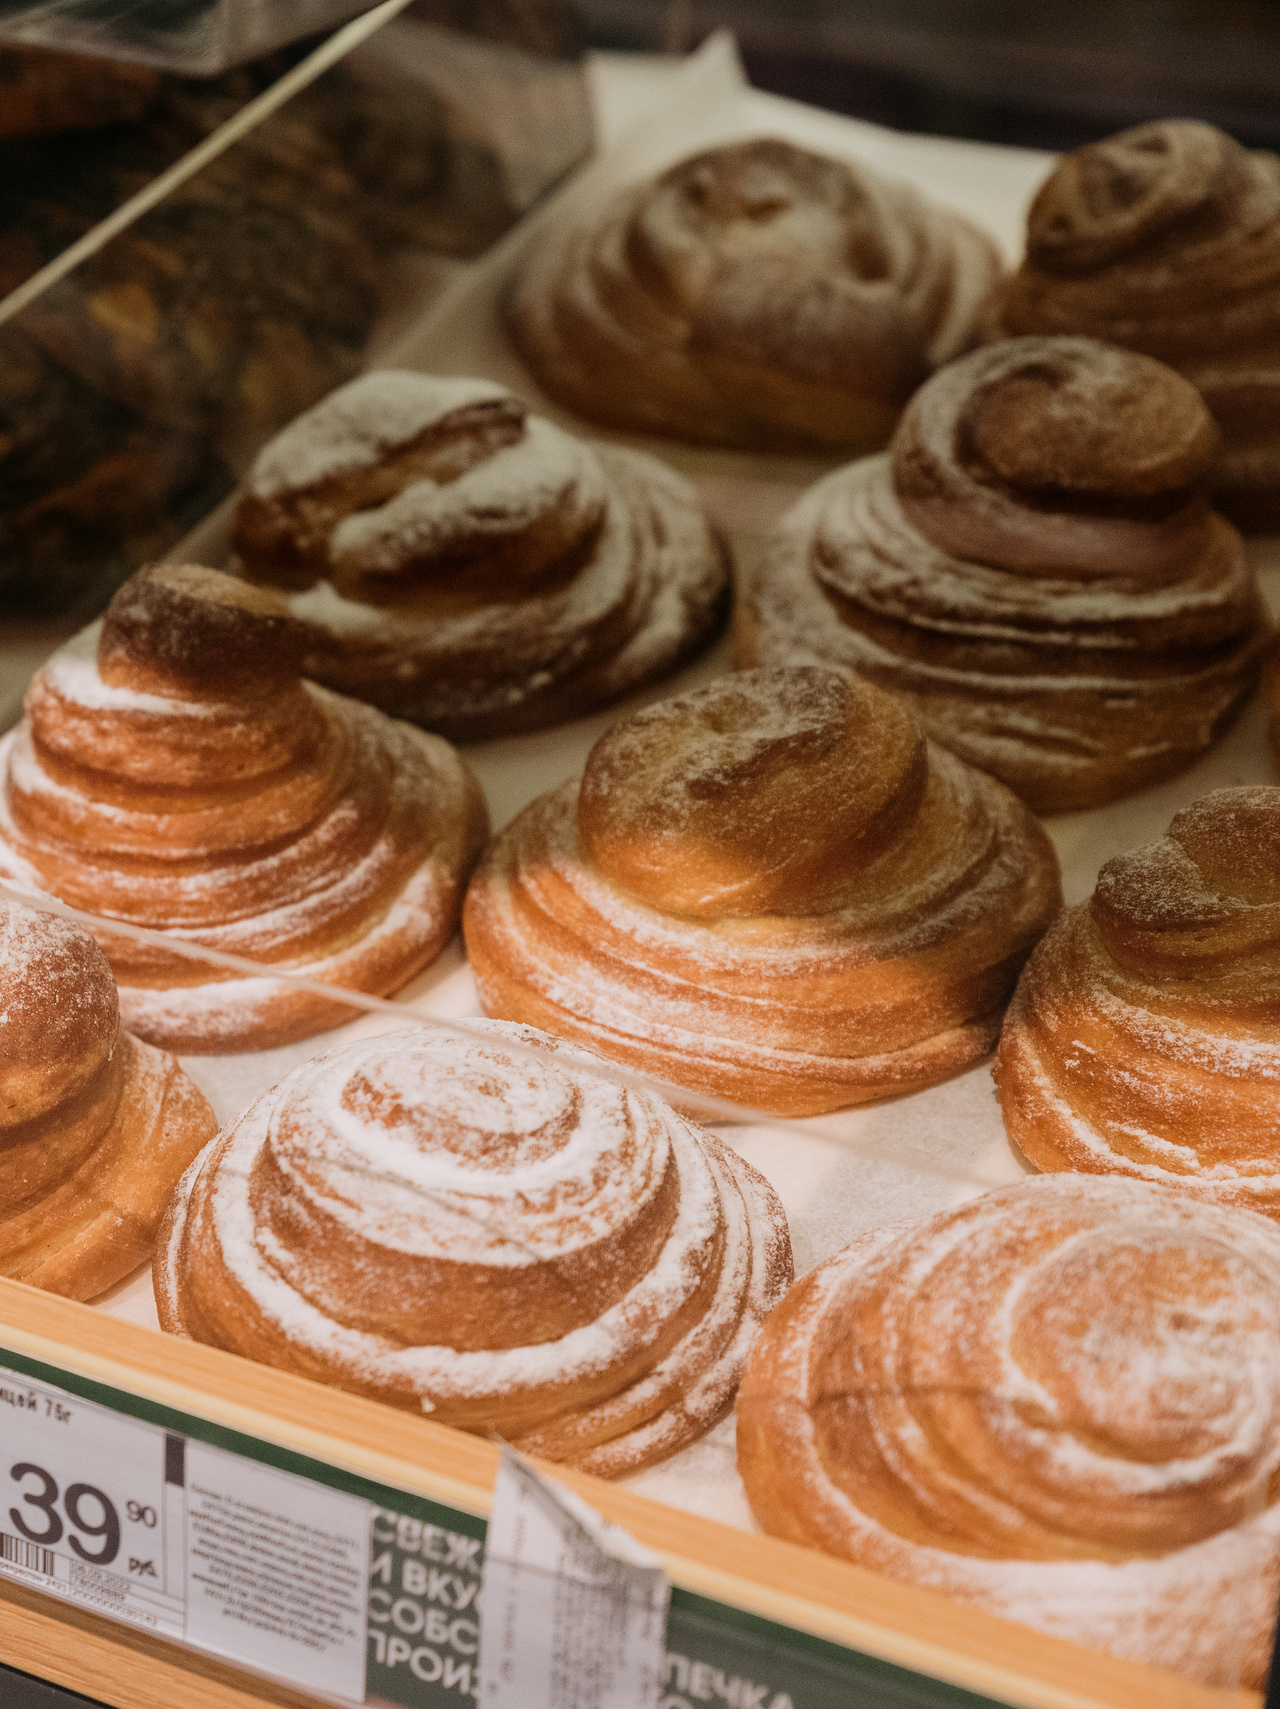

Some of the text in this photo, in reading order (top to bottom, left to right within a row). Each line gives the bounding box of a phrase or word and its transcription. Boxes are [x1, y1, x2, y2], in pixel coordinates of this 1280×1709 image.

[43, 1399, 73, 1424] 75г
[9, 1462, 157, 1566] 39 90
[369, 1505, 483, 1575] СВЕЖ
[401, 1557, 479, 1611] ВКУ
[368, 1588, 479, 1655] СОБС
[368, 1628, 478, 1698] ПРОИ
